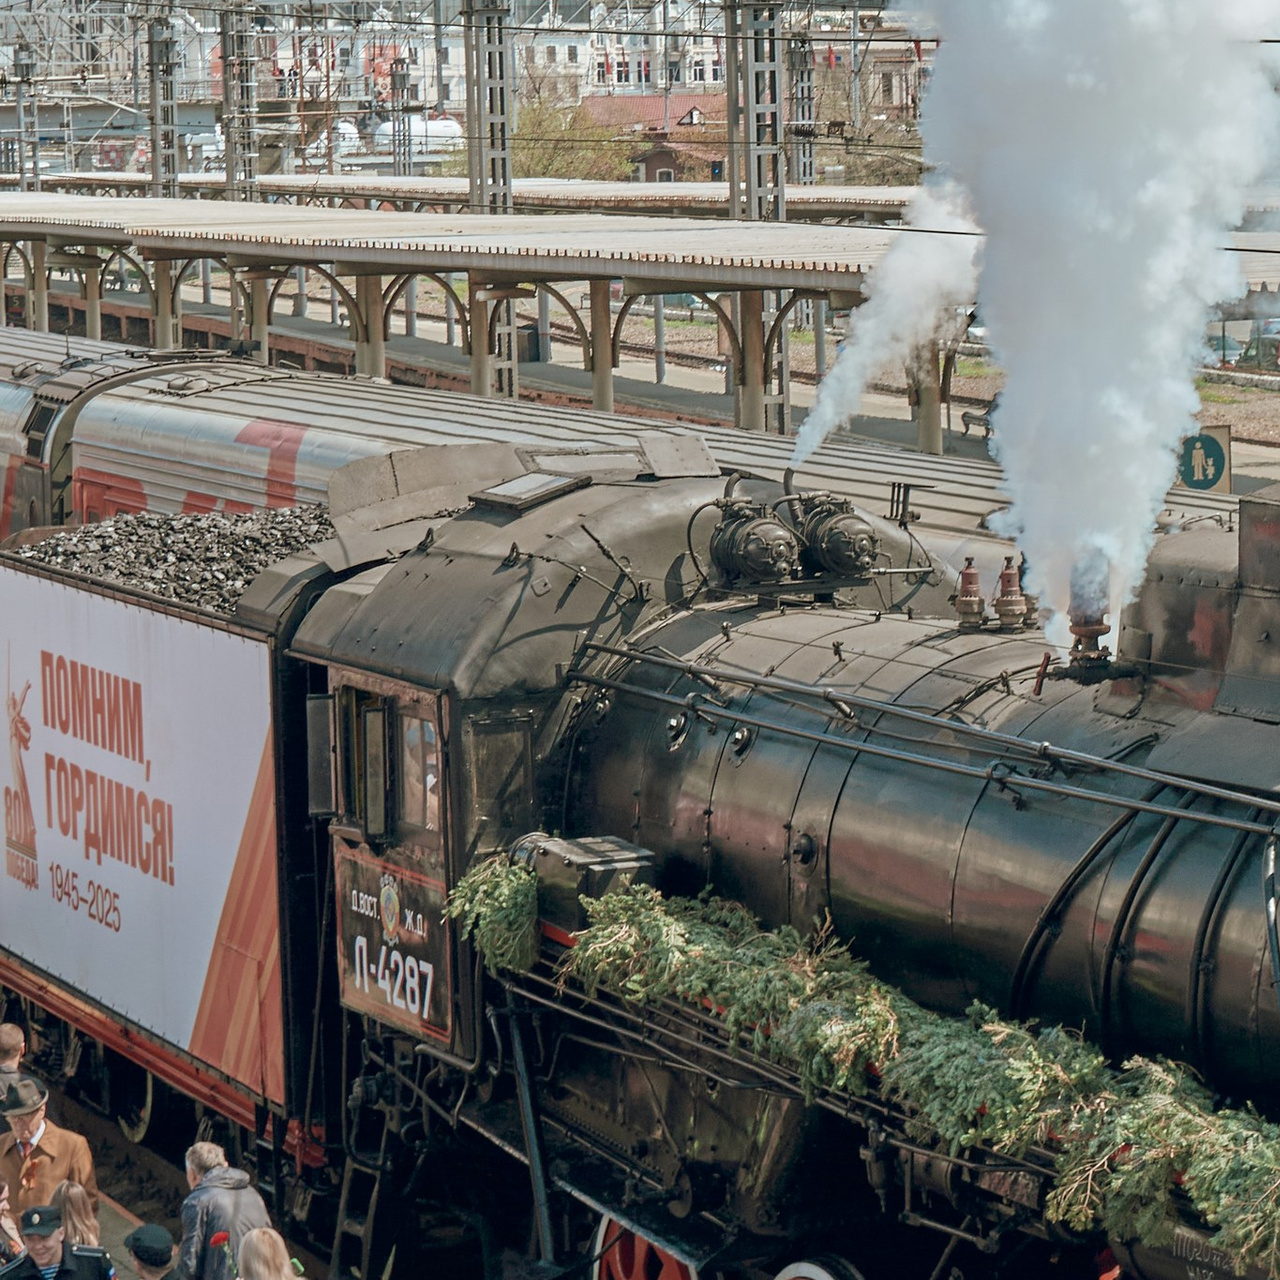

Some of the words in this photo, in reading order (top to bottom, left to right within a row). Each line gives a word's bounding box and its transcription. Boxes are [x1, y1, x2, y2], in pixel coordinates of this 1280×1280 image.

[41, 650, 151, 782] ПОМНИМ,
[6, 848, 39, 890] ПОБЕДА!
[44, 752, 175, 886] ГОРДИМСЯ!
